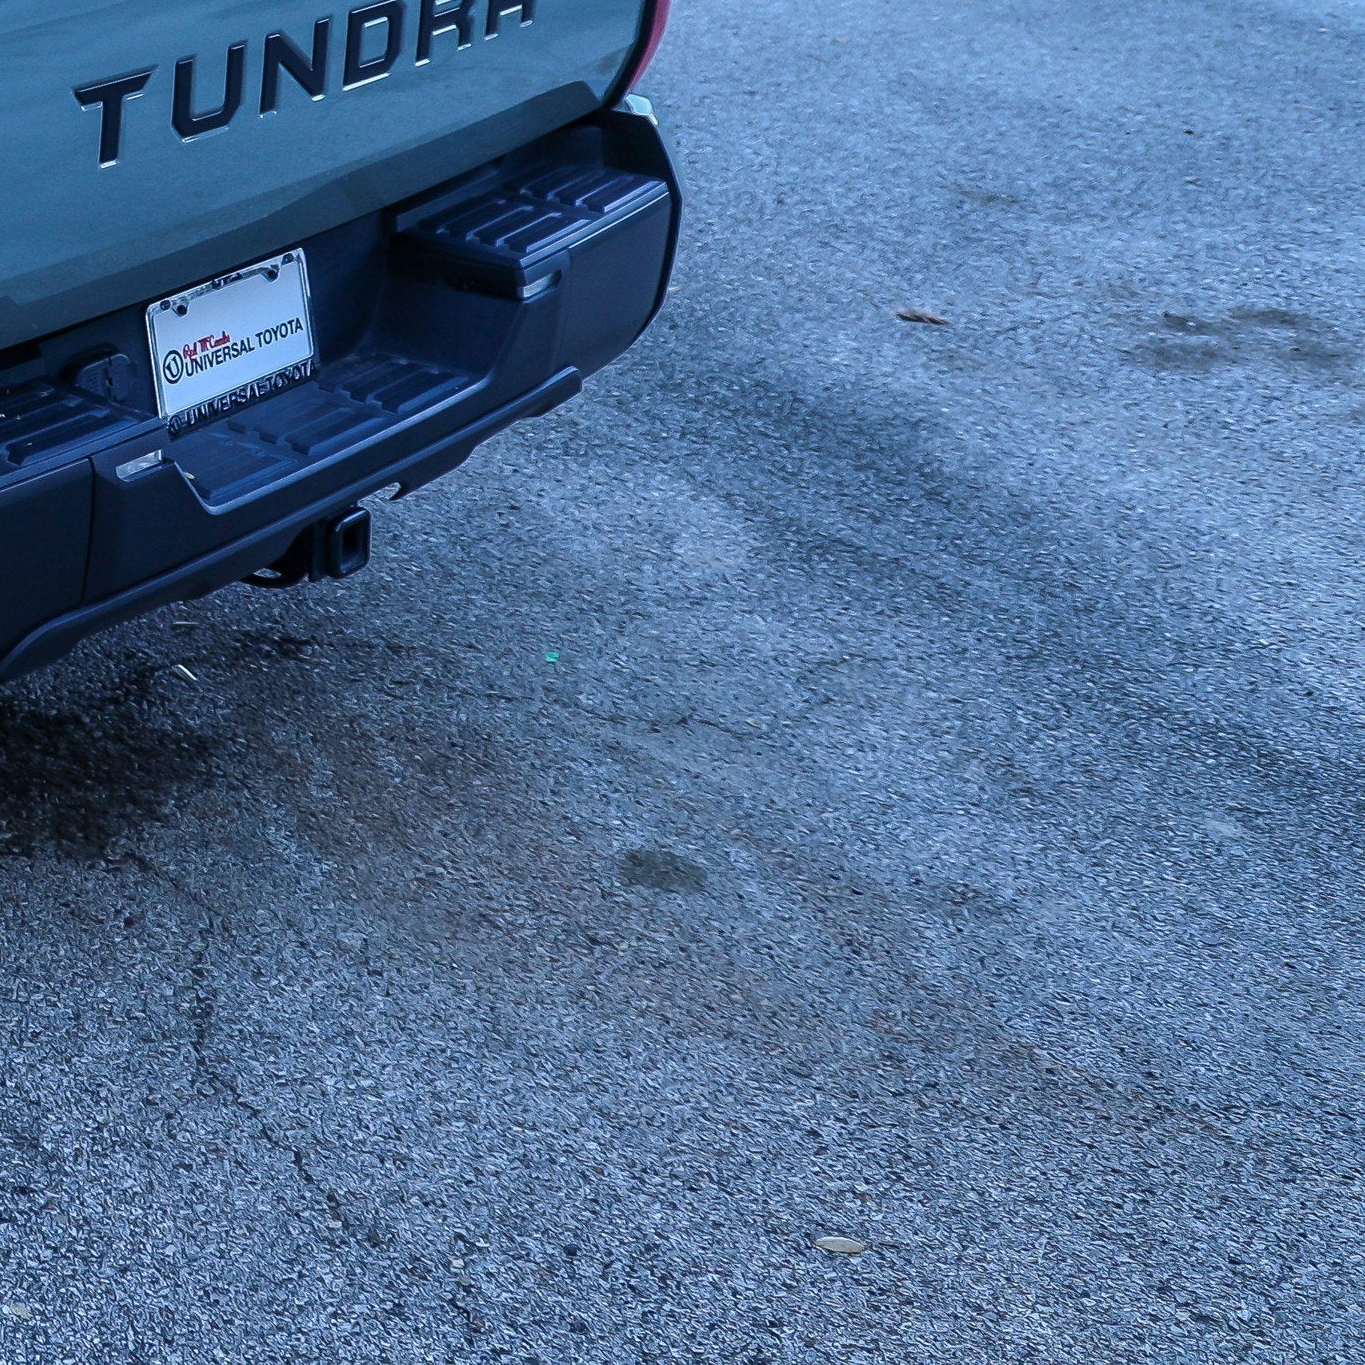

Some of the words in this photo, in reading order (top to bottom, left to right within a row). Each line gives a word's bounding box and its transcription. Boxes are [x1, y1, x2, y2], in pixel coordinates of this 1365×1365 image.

[185, 337, 256, 377] UNIVERSAL
[255, 317, 304, 348] TOYOTA
[185, 382, 267, 425] UNIVERSAL
[264, 360, 318, 392] TOYOTA
